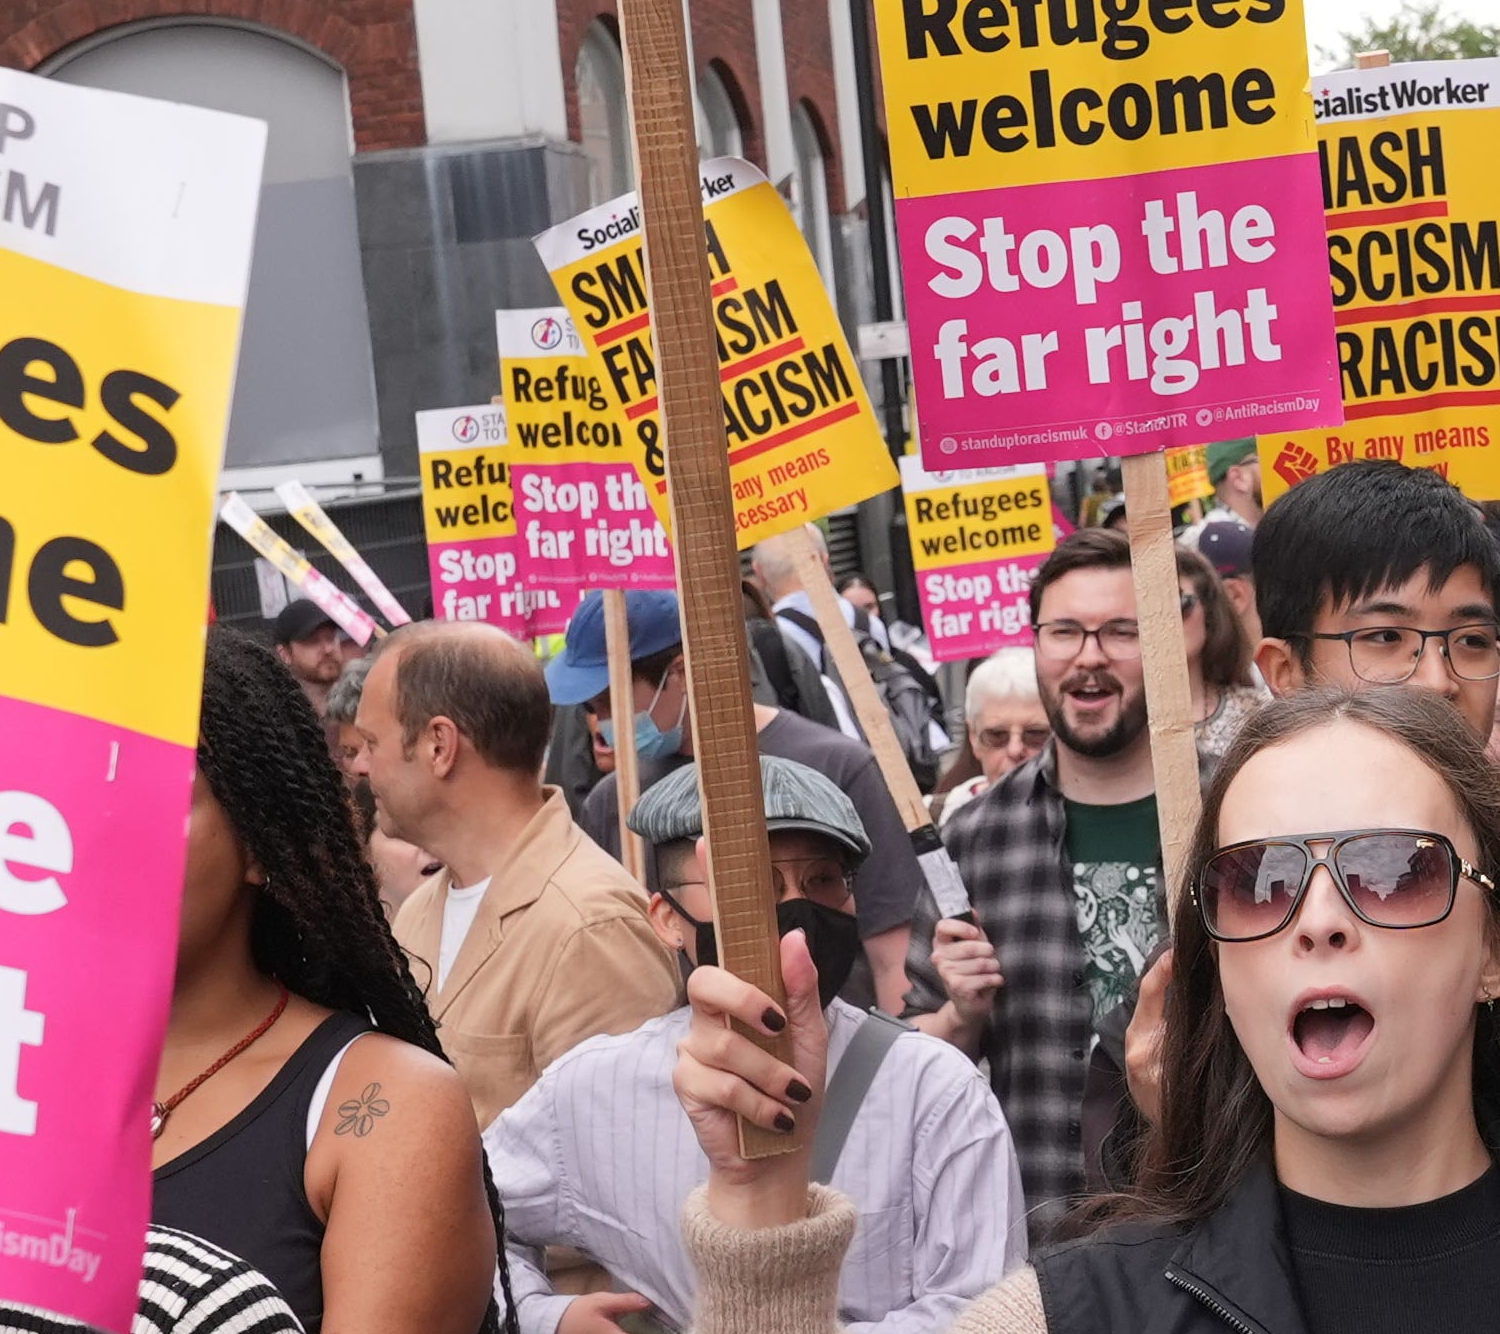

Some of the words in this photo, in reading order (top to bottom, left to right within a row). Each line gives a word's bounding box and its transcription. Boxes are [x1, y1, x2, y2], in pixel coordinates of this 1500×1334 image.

[911, 67, 1276, 160] welcome
[924, 215, 1119, 306] Stop
[1141, 190, 1276, 274] the
[933, 318, 1058, 399] far
[1086, 288, 1282, 396] right
[961, 425, 1088, 452] standuptoracismuk
[1114, 412, 1187, 437] @StandUTR
[1214, 395, 1320, 423] @AntiRacismDay
[1327, 437, 1354, 465] By
[1365, 434, 1404, 460] any
[1414, 426, 1490, 456] means
[733, 477, 763, 501] any
[768, 447, 830, 483] means
[521, 473, 598, 519] Stop
[915, 489, 1043, 524] Refugees
[525, 520, 574, 559] far
[585, 519, 668, 566] right
[921, 523, 1041, 557] welcome
[439, 549, 516, 586] Stop
[442, 589, 491, 621] far
[925, 573, 991, 607] Stop
[931, 609, 972, 638] far
